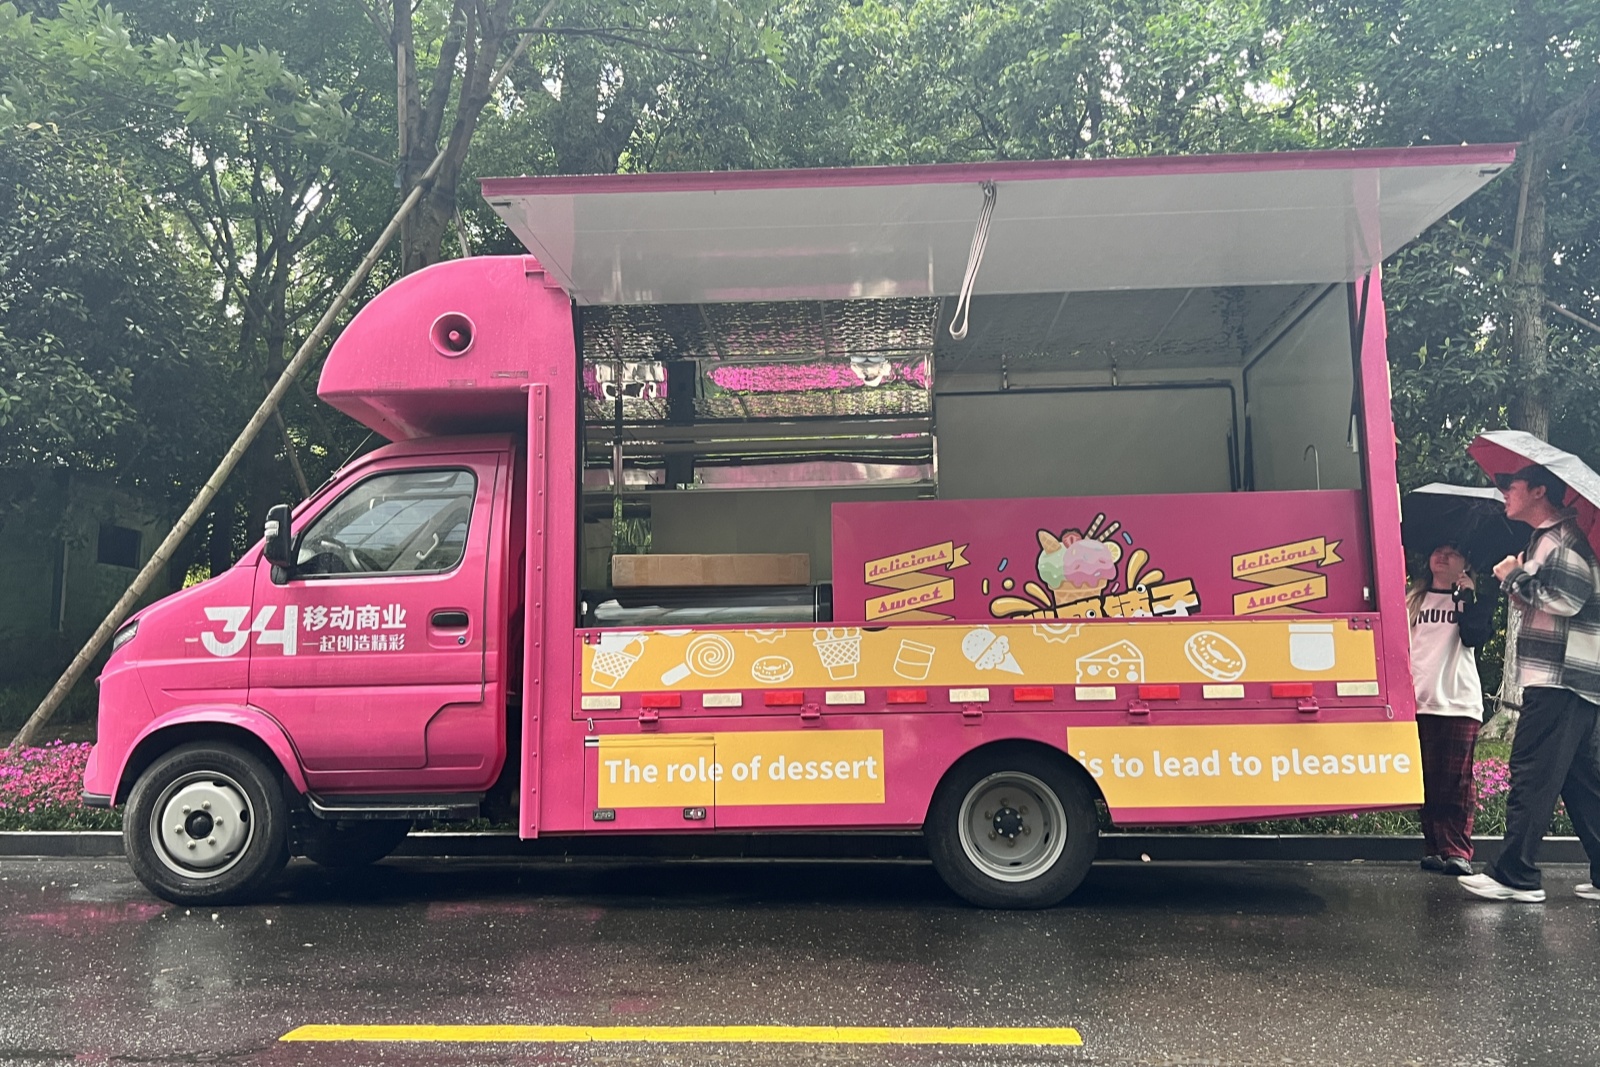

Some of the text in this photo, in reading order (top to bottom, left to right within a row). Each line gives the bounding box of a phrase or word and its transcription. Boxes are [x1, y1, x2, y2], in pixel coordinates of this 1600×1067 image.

[868, 549, 947, 577] delicious
[1236, 545, 1319, 572] delicious
[878, 586, 943, 613] sweet
[1246, 583, 1315, 609] sweet
[302, 603, 407, 631] 移动商业
[302, 633, 405, 652] 一起创造精彩
[604, 755, 878, 783] The role of dessert
[1078, 748, 1411, 782] is to lead to pleasure
